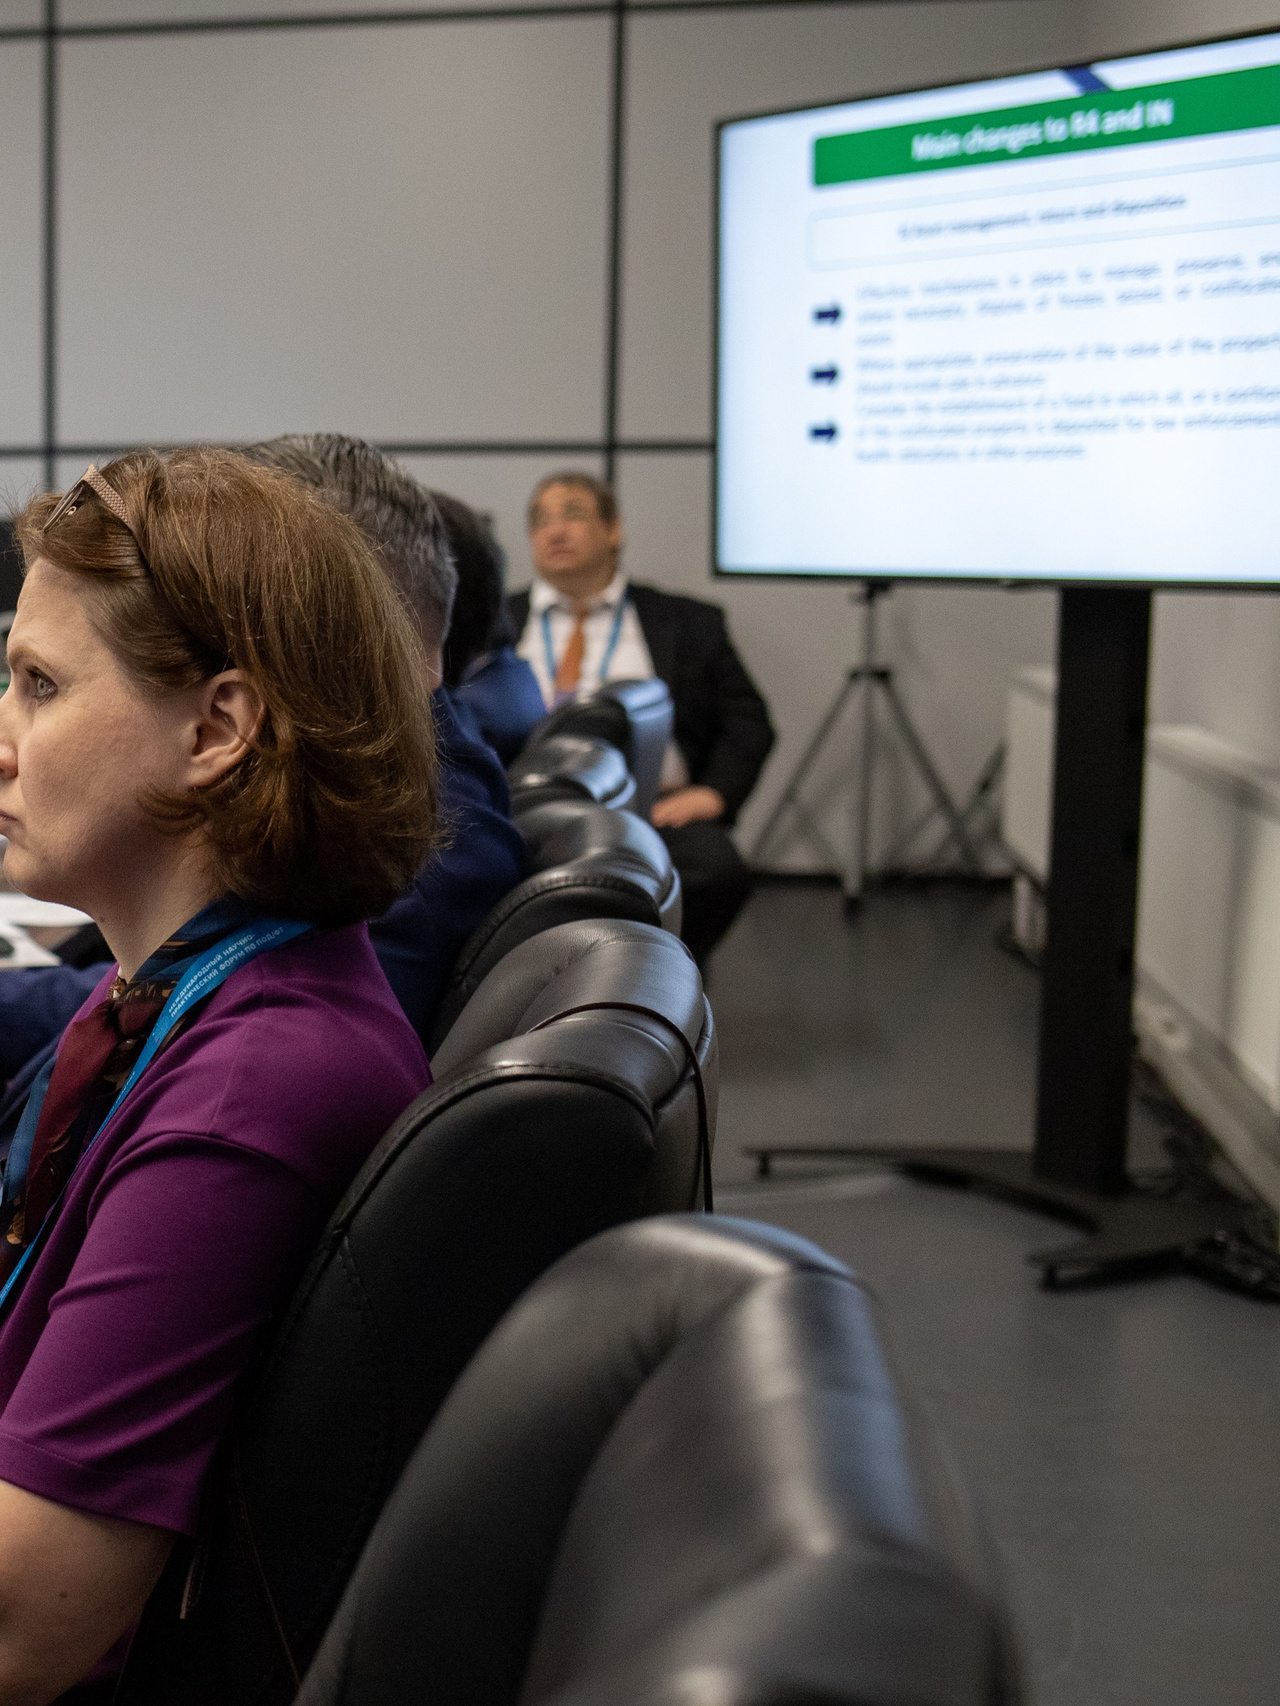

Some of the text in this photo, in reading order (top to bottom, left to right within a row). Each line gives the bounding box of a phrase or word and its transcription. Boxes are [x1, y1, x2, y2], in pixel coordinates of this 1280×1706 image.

[911, 130, 961, 161] Main
[962, 124, 1043, 154] changes
[1043, 116, 1069, 143] to
[1100, 100, 1145, 135] and
[169, 934, 255, 1013] МЕЖДУНАРОДНЫЙ НАУЧНО-
[170, 927, 284, 1018] ПРАКТИЧЕСКИЙ ФОРУМ ПО ПОД/ФТ
